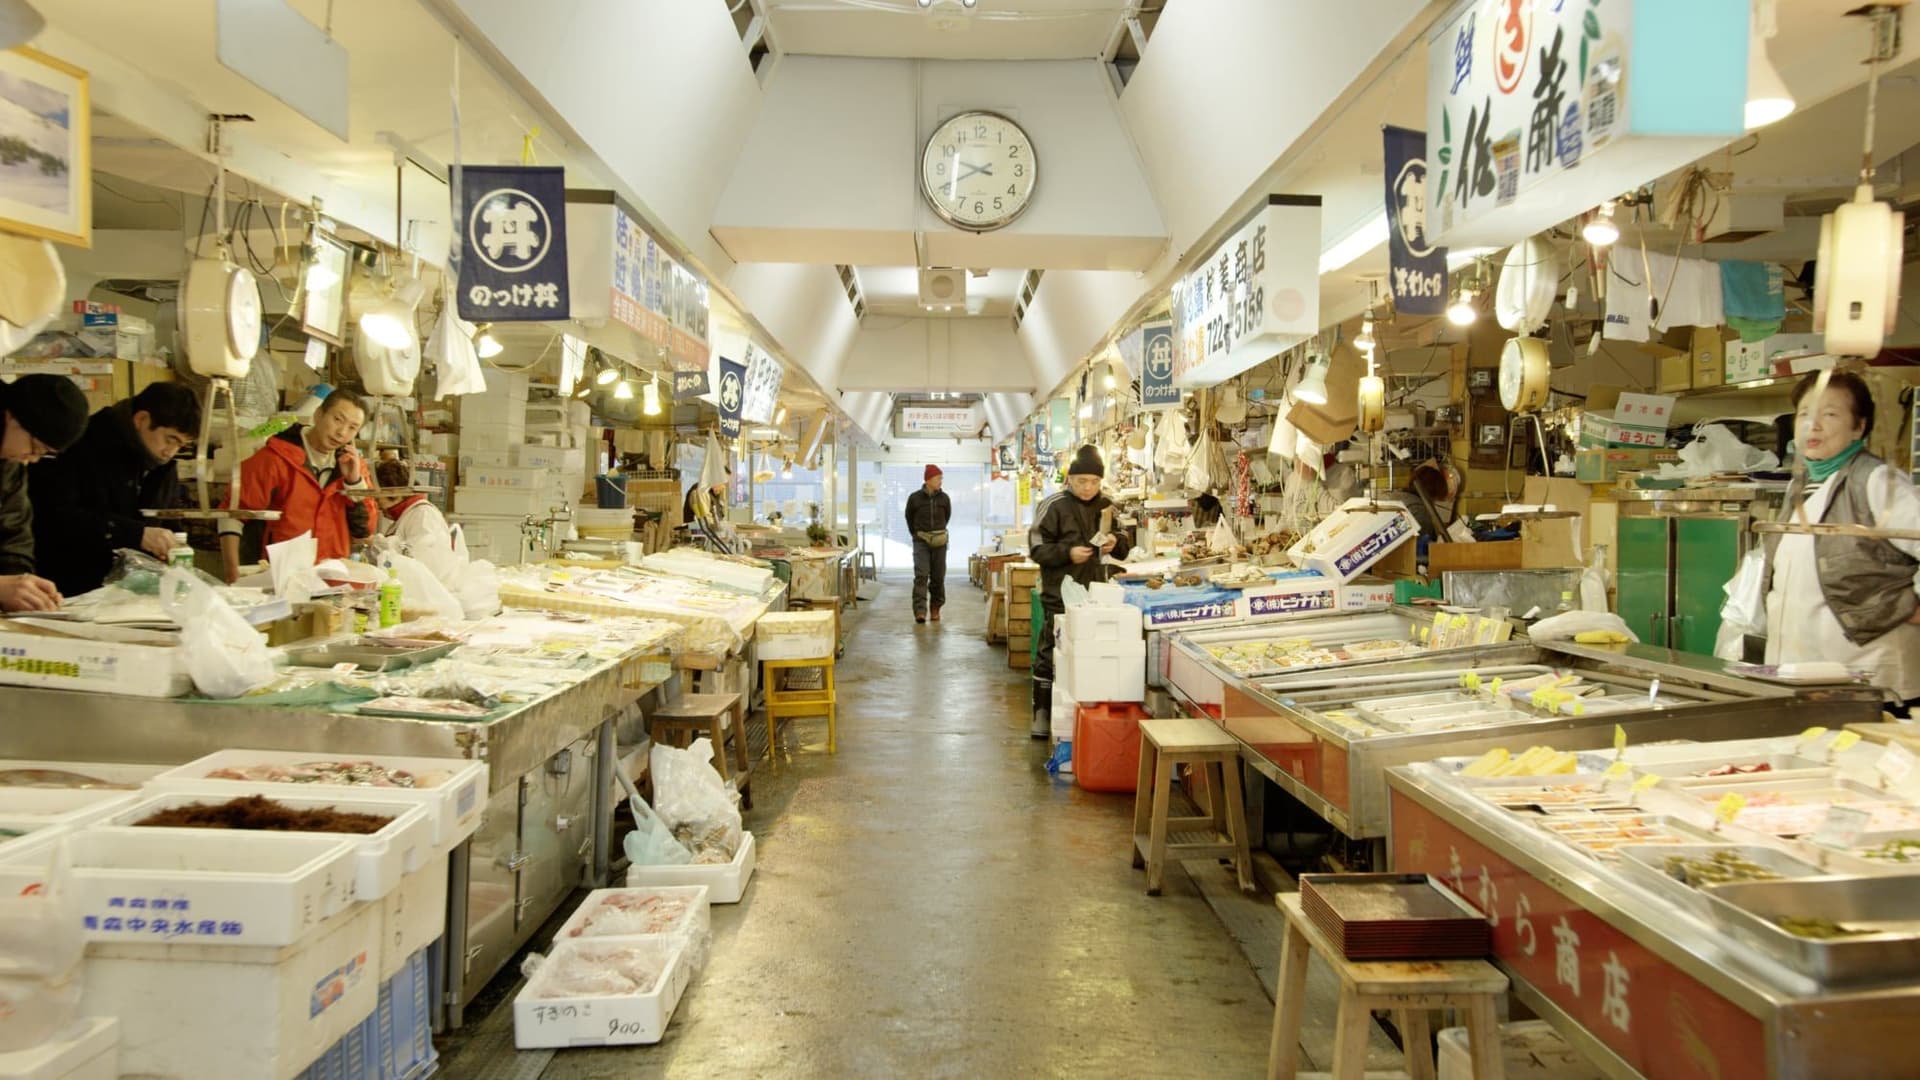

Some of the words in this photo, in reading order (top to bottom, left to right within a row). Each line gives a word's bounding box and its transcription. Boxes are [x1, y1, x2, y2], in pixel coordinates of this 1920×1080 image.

[958, 131, 967, 144] 11
[974, 125, 987, 139] 12
[997, 131, 1002, 144] 1
[942, 144, 956, 158] 10
[1008, 145, 1019, 158] 2
[935, 162, 945, 176] 9
[1014, 164, 1023, 177] 3
[1007, 183, 1017, 197] 4
[958, 196, 968, 209] 7
[974, 201, 984, 215] 6
[993, 196, 1002, 210] 5
[469, 282, 560, 308] のっけ丼
[1619, 431, 1657, 446] 塩うに
